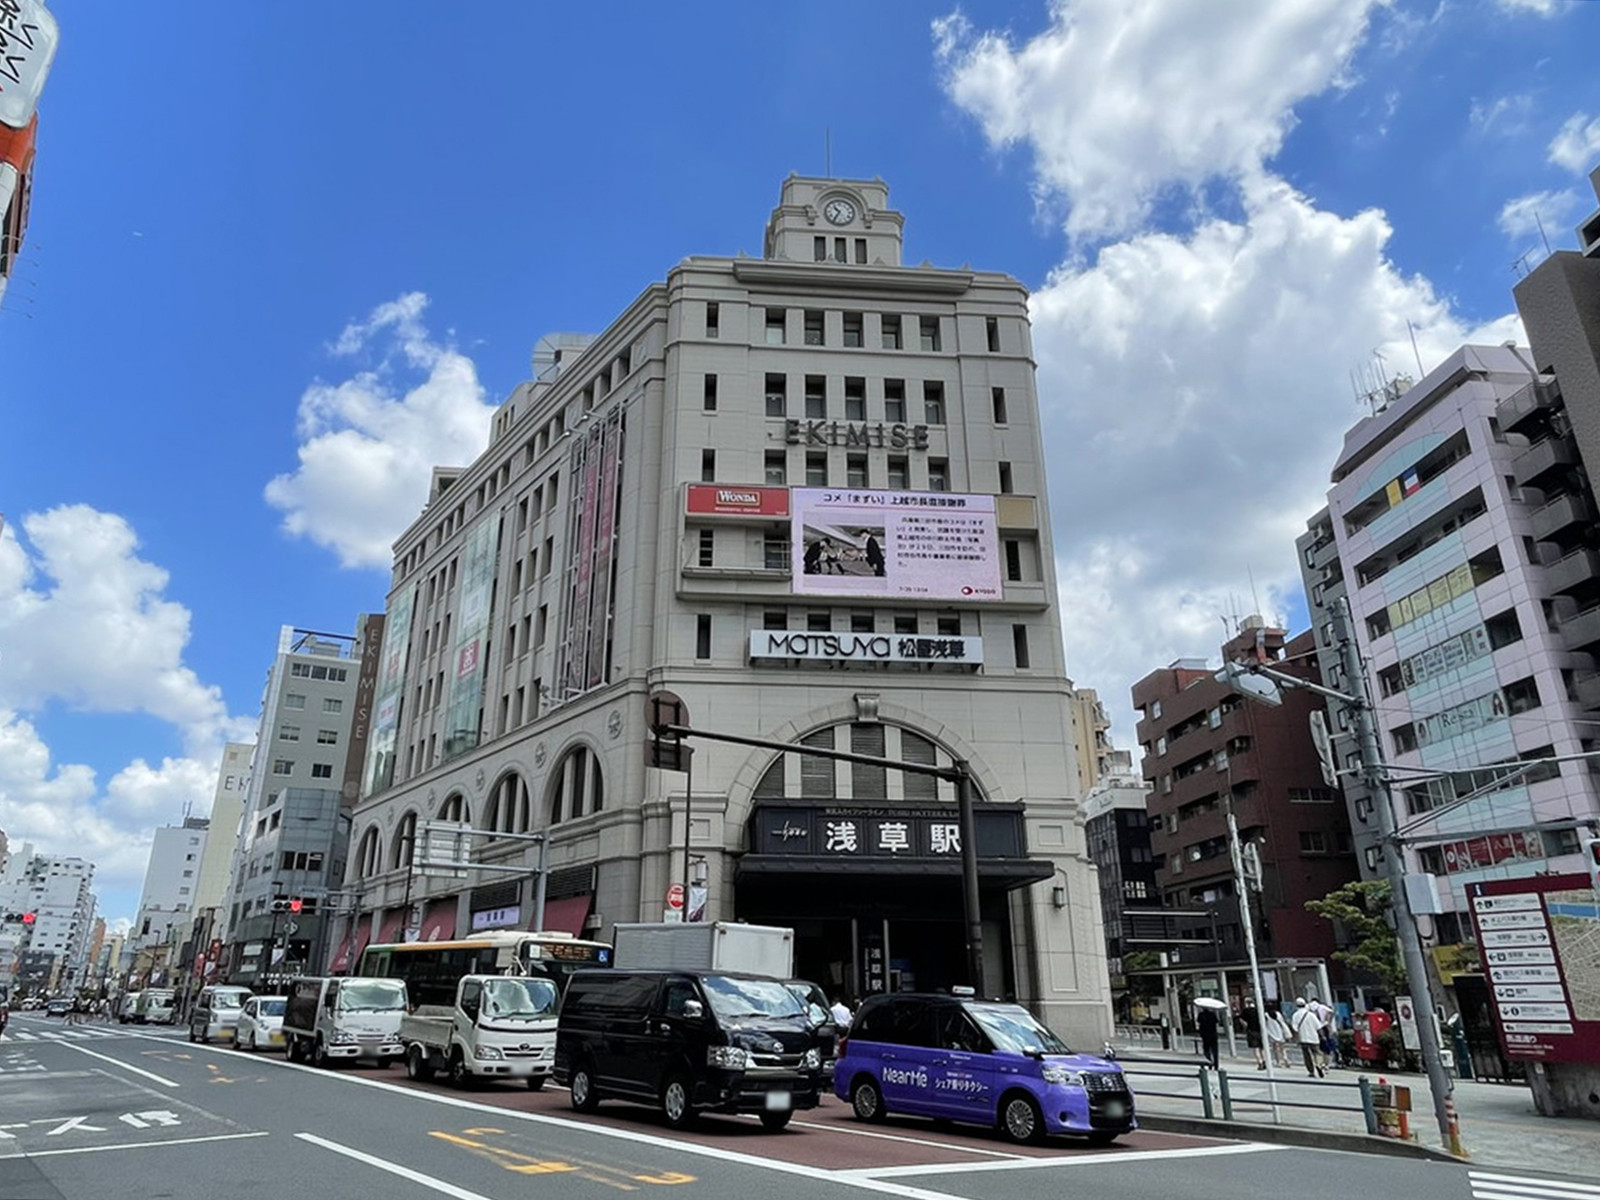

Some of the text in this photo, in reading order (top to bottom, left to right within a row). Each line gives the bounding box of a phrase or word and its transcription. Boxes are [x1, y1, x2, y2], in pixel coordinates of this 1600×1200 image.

[784, 419, 929, 450] EKIMISE
[718, 490, 757, 503] WONDA
[898, 637, 966, 659] 松屋浅草
[355, 628, 380, 739] EKIMISE
[825, 821, 962, 854] 浅草駅
[883, 1065, 928, 1088] NearMe
